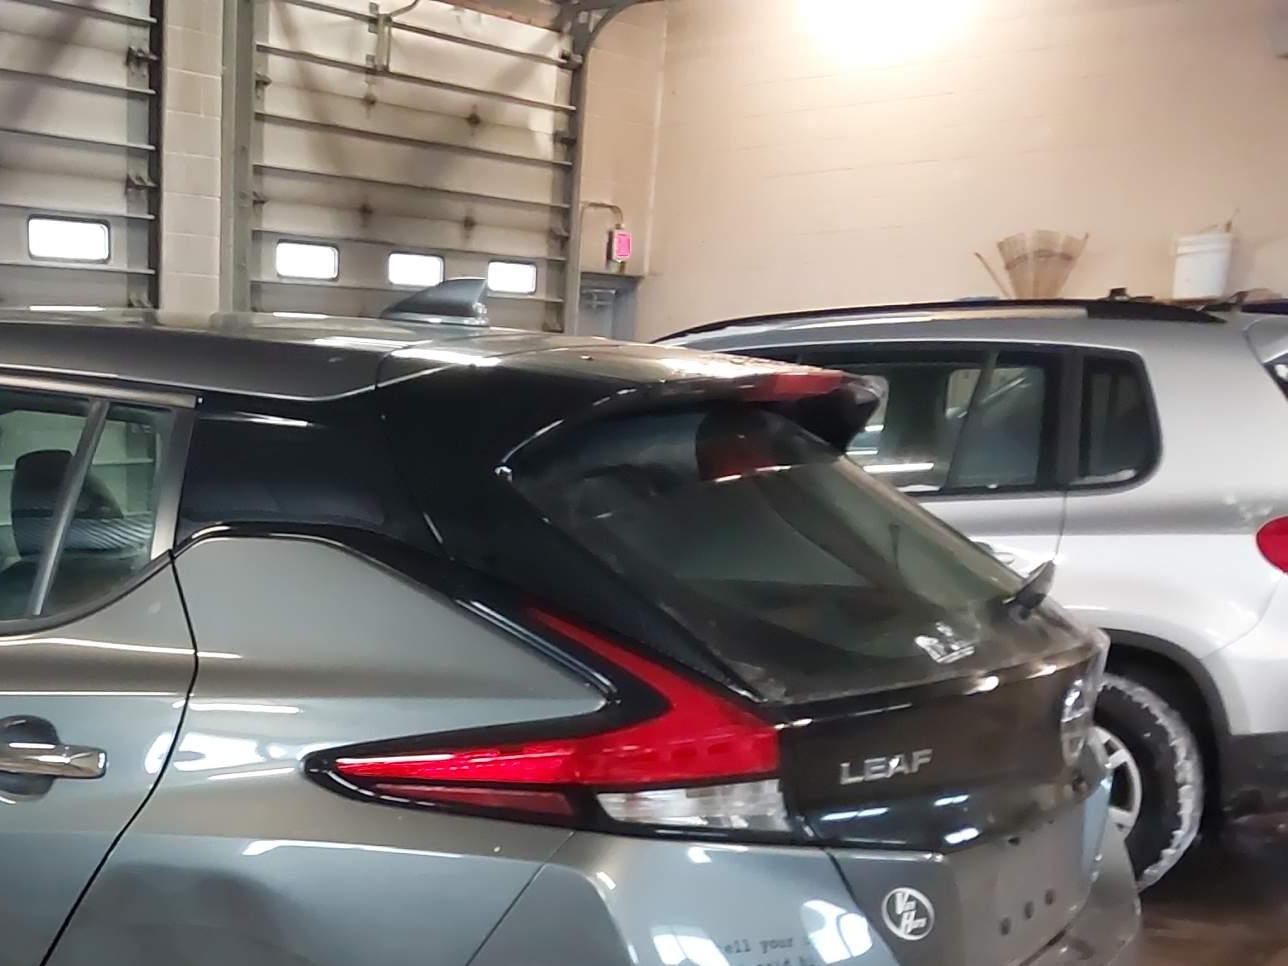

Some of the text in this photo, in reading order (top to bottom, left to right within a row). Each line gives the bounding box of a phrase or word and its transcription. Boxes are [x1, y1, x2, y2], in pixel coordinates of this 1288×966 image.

[839, 748, 933, 785] LEAF
[723, 938, 752, 955] ell
[759, 936, 794, 955] your
